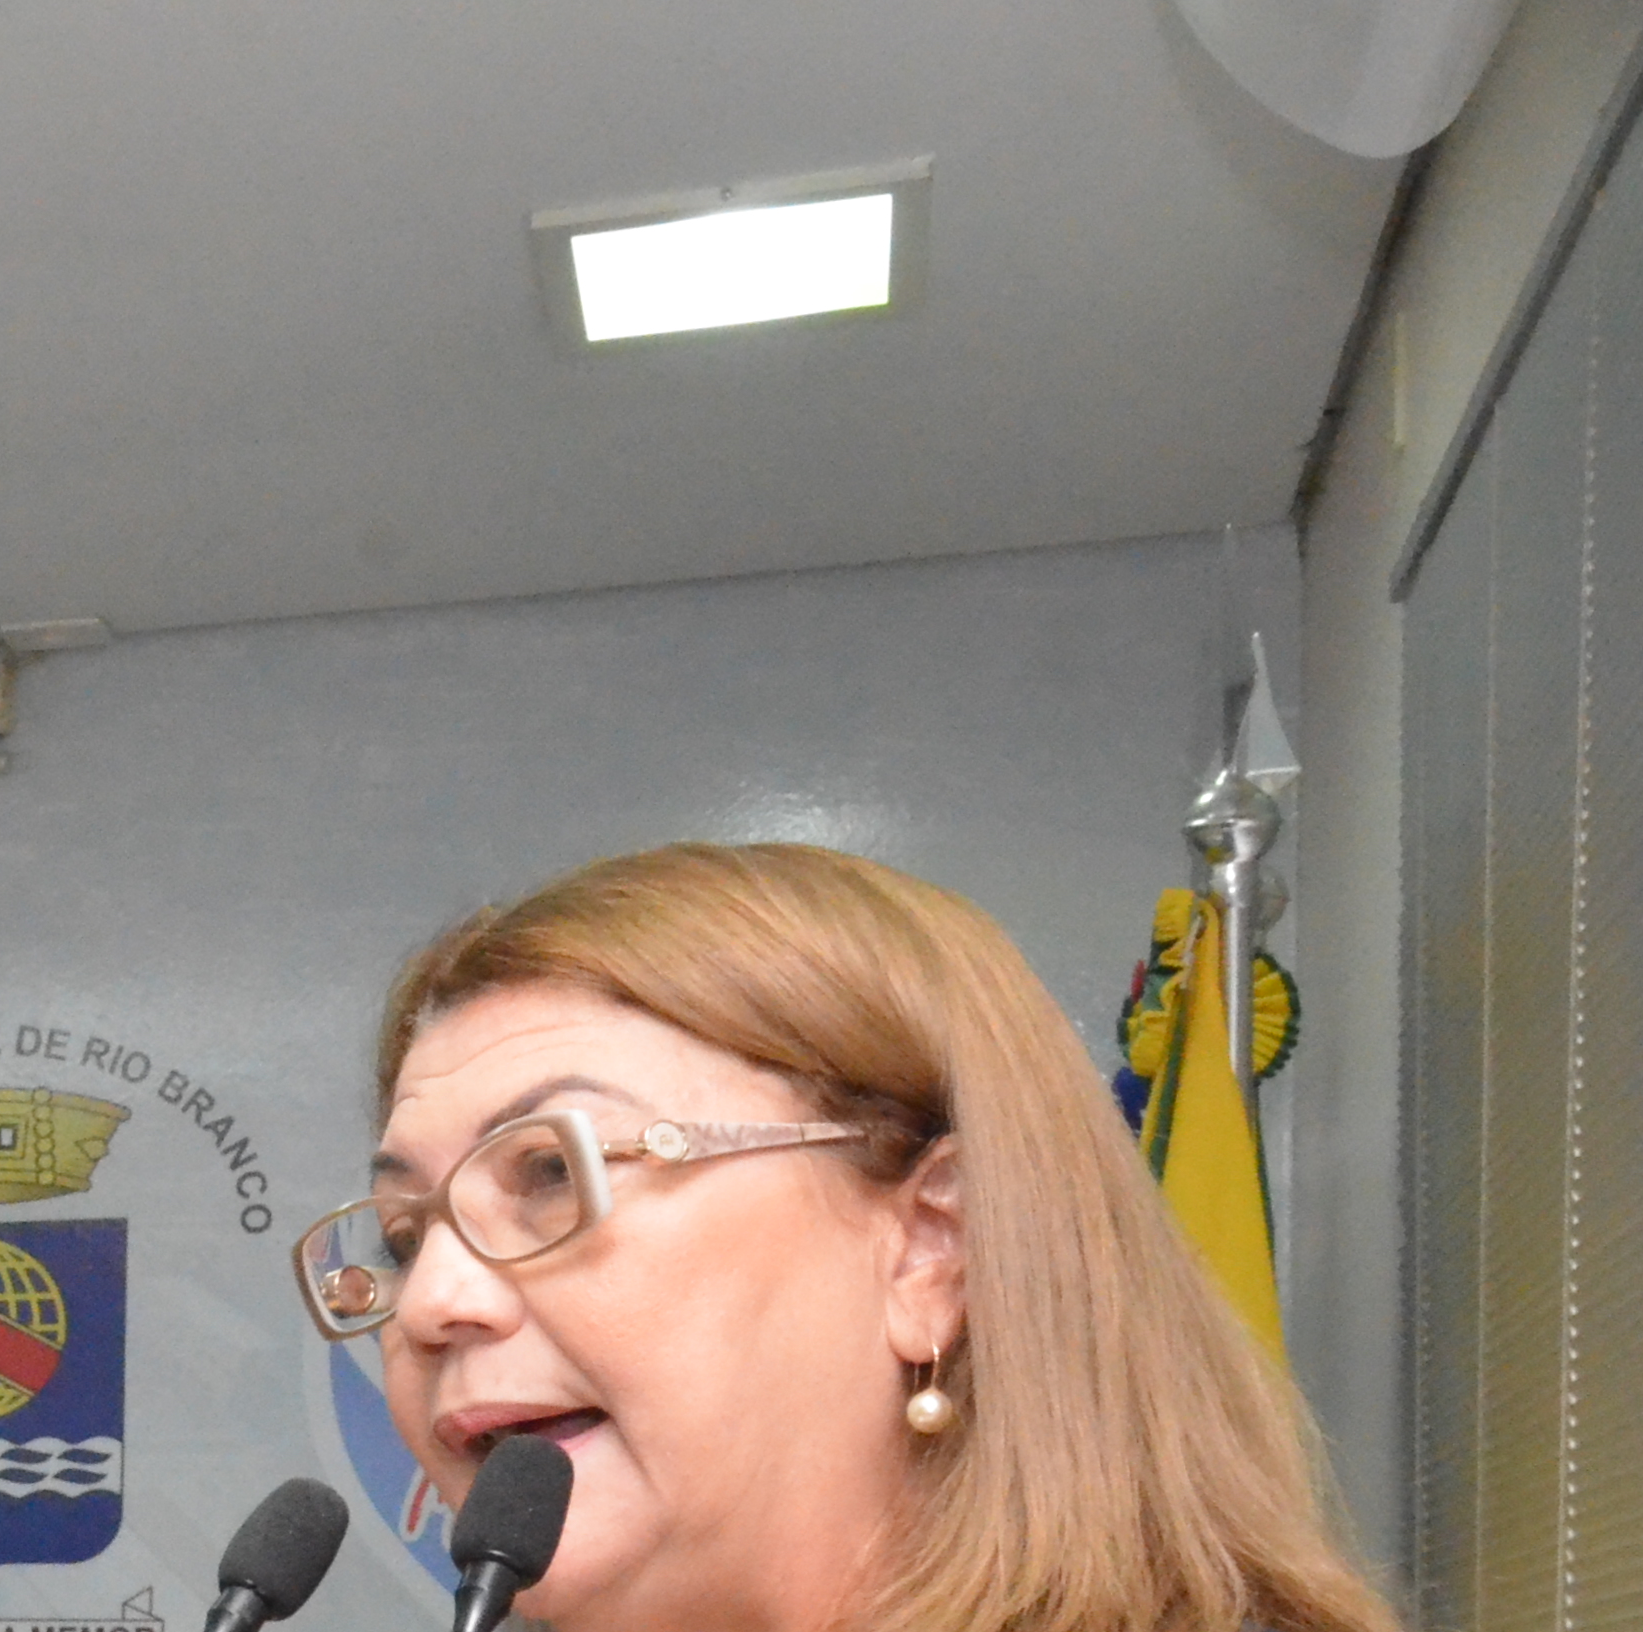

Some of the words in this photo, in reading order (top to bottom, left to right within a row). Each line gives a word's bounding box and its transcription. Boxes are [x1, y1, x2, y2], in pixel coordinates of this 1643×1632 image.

[15, 1025, 71, 1061] DE
[79, 1036, 151, 1083] RIO
[157, 1069, 272, 1234] BRANCO
